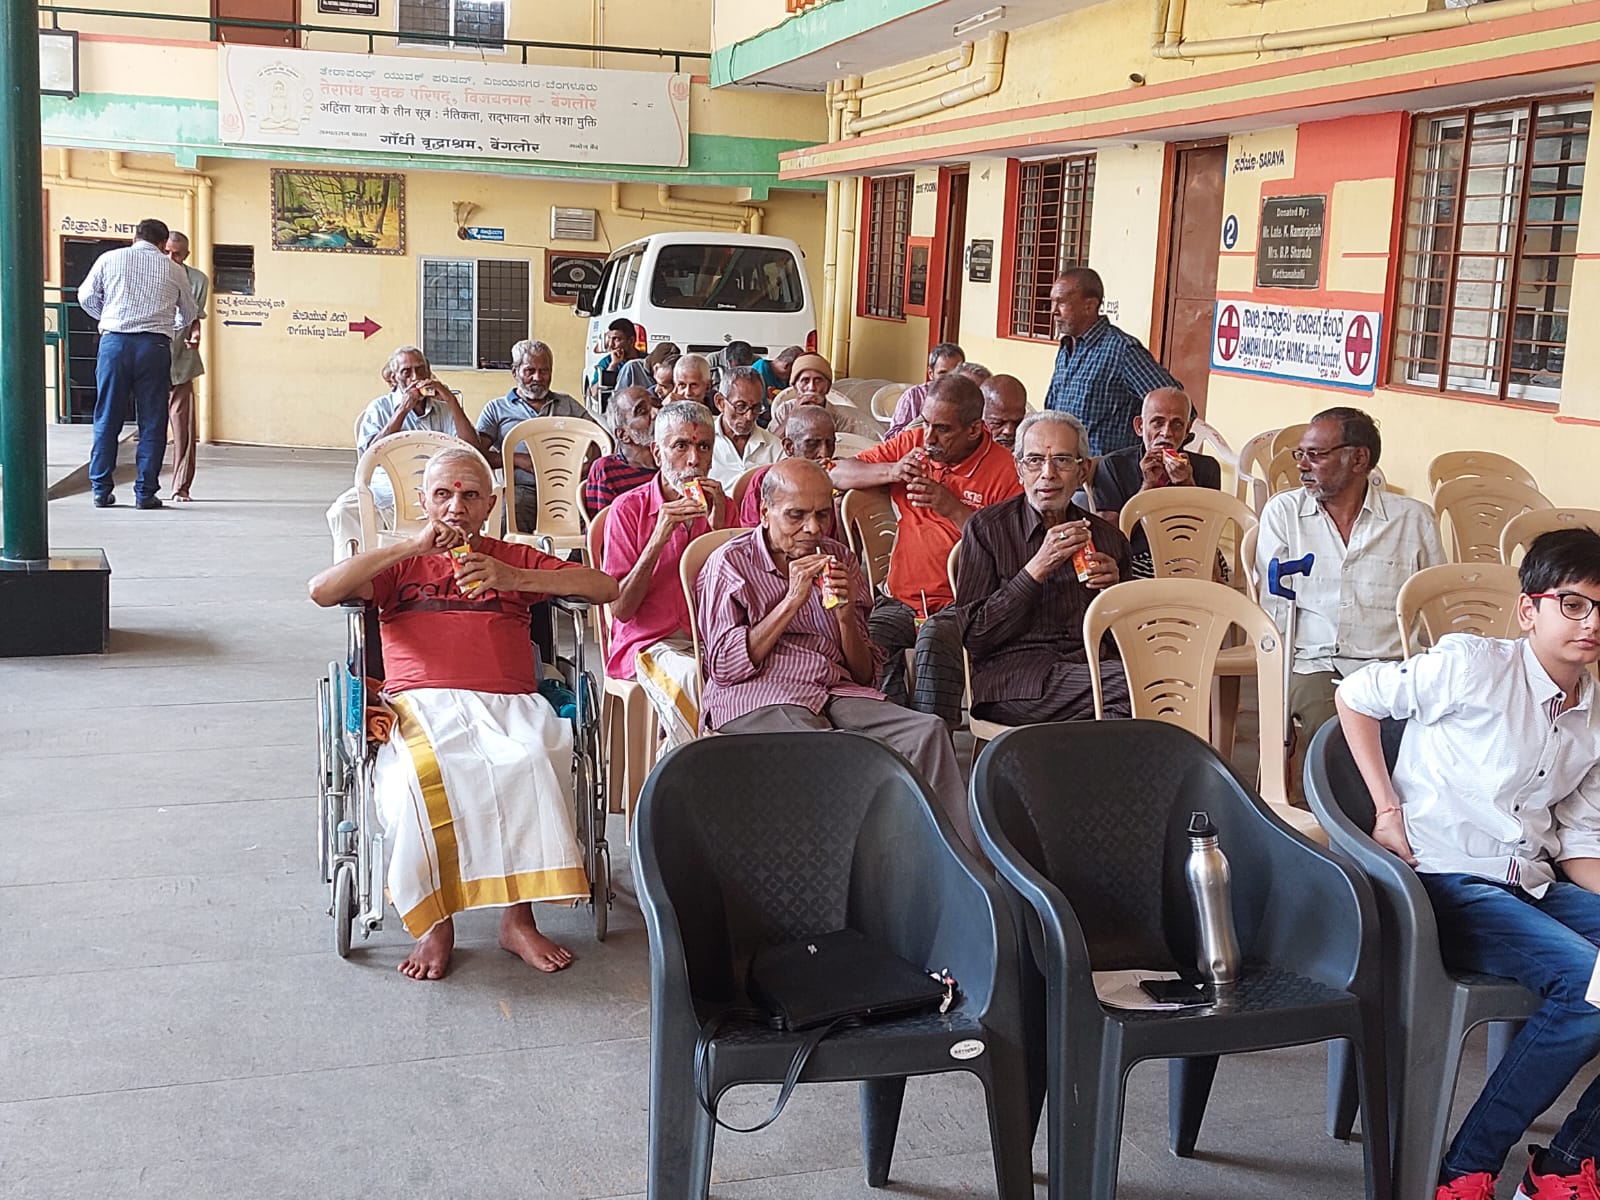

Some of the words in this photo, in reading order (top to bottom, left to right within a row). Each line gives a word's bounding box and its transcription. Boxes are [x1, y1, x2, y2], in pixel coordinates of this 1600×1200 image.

[464, 87, 532, 107] विजयनगर
[320, 100, 351, 114] अहिंसा
[354, 104, 376, 115] यात्रा
[380, 103, 390, 115] के
[393, 104, 412, 117] तीन
[415, 107, 431, 121] सूत्र
[533, 112, 552, 125] और
[554, 116, 574, 126] नशा
[577, 115, 597, 129] मुक्ति
[489, 137, 541, 154] बेंगलोर
[1276, 207, 1298, 217] Donated
[1299, 207, 1306, 218] By
[1226, 218, 1234, 245] 2
[240, 309, 269, 319] Laundry
[287, 324, 326, 339] Drinking
[1239, 335, 1261, 359] GANDHI
[1261, 337, 1273, 359] OLD
[1273, 339, 1285, 363] AGE
[1285, 341, 1305, 364] HOME
